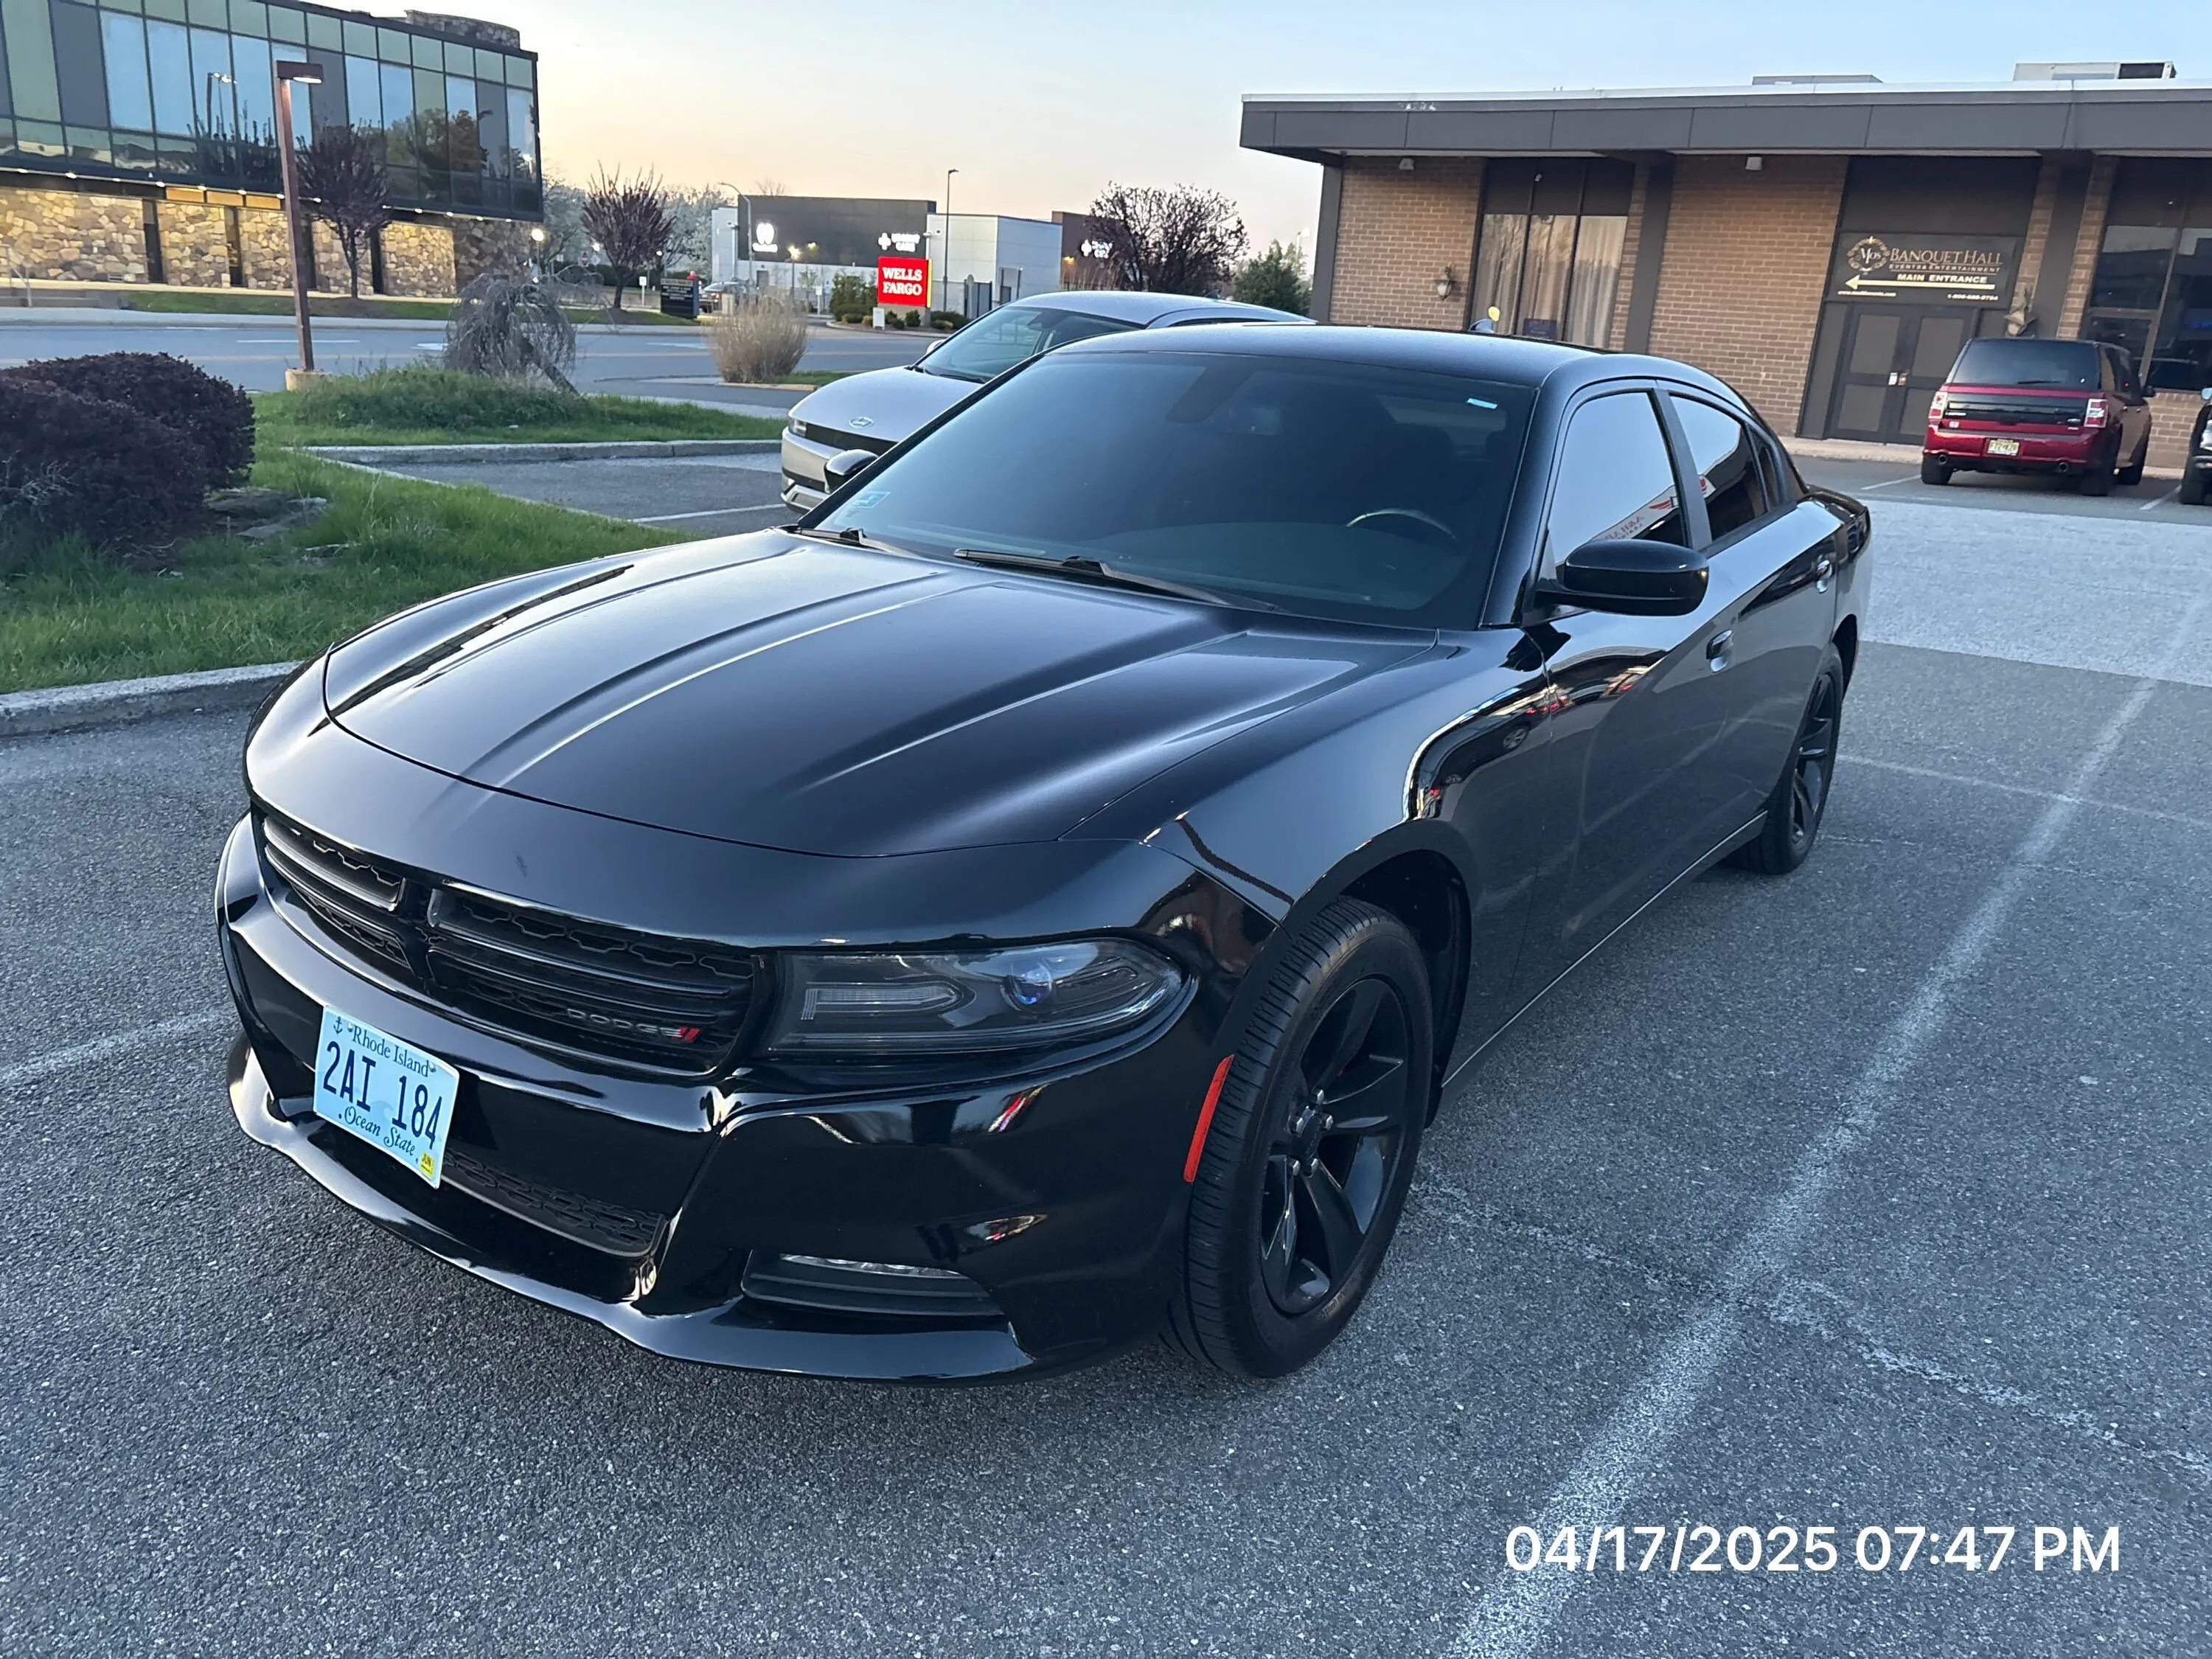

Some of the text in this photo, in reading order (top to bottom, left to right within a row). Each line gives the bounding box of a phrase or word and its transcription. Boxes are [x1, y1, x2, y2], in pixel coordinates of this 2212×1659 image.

[1890, 248, 2003, 265] BANQUET HALL
[882, 267, 922, 281] WELLS
[1929, 274, 1988, 284] ENTRANCE
[883, 282, 922, 296] FARGO
[567, 1008, 682, 1038] DODGE
[352, 1024, 429, 1077] Rhode Island
[323, 1040, 442, 1150] 2AI 184
[344, 1106, 416, 1157] Ocean State
